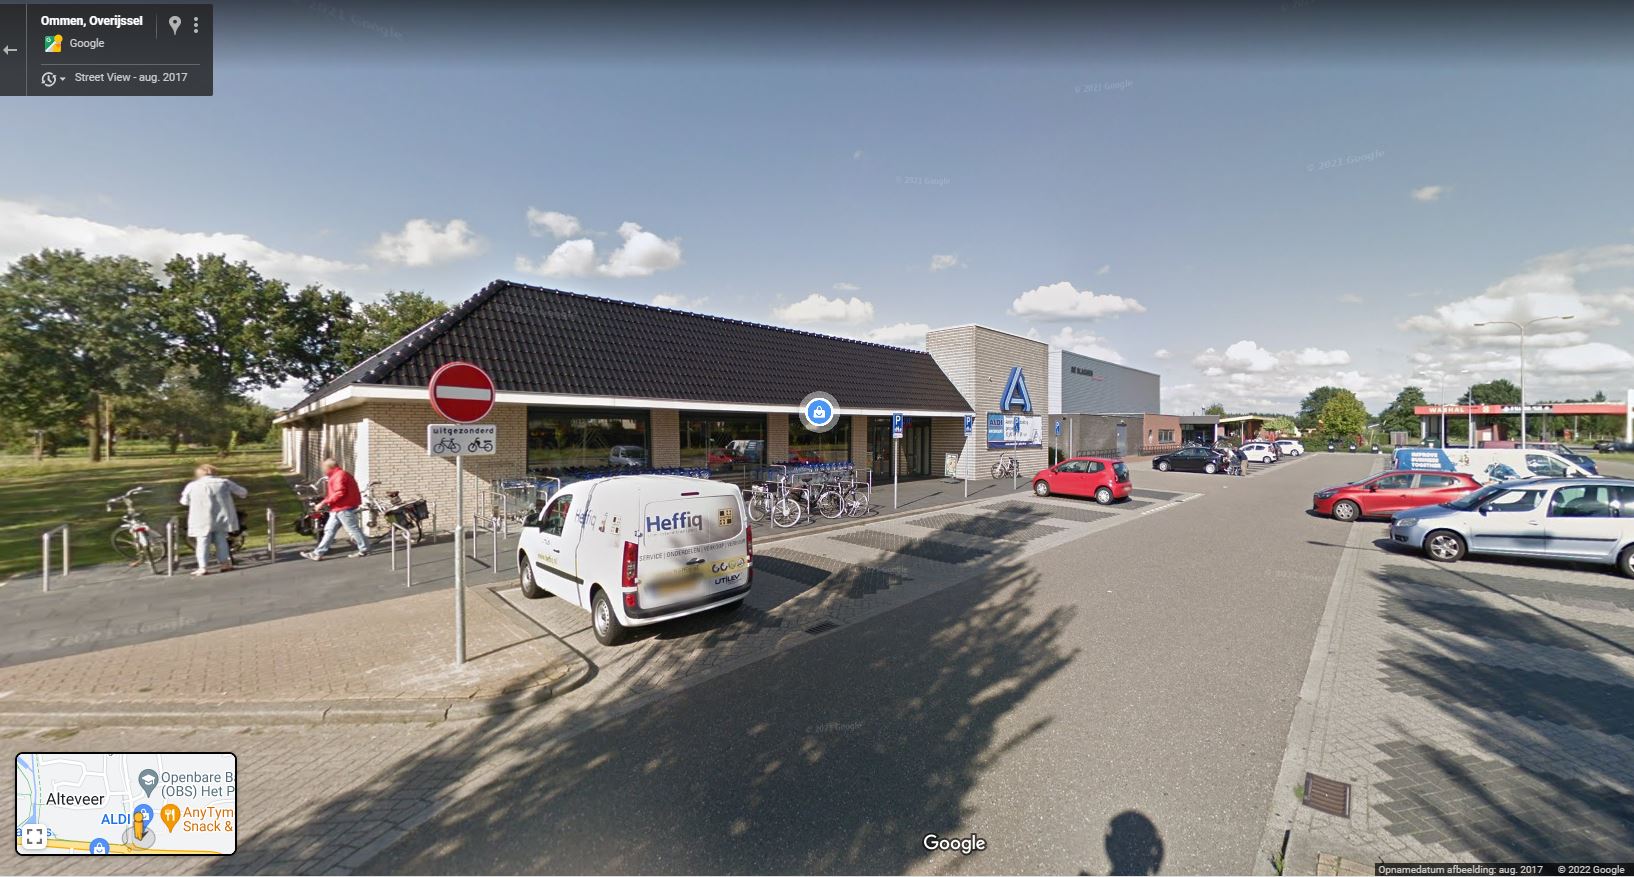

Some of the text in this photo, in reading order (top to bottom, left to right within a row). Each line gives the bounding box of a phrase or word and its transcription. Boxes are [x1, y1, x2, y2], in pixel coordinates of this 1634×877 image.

[895, 415, 901, 425] P
[432, 427, 494, 436] uitgezonderd
[646, 511, 703, 532] Heffiq
[639, 553, 663, 562] SERVICE
[666, 548, 701, 558] ONDERDELEN
